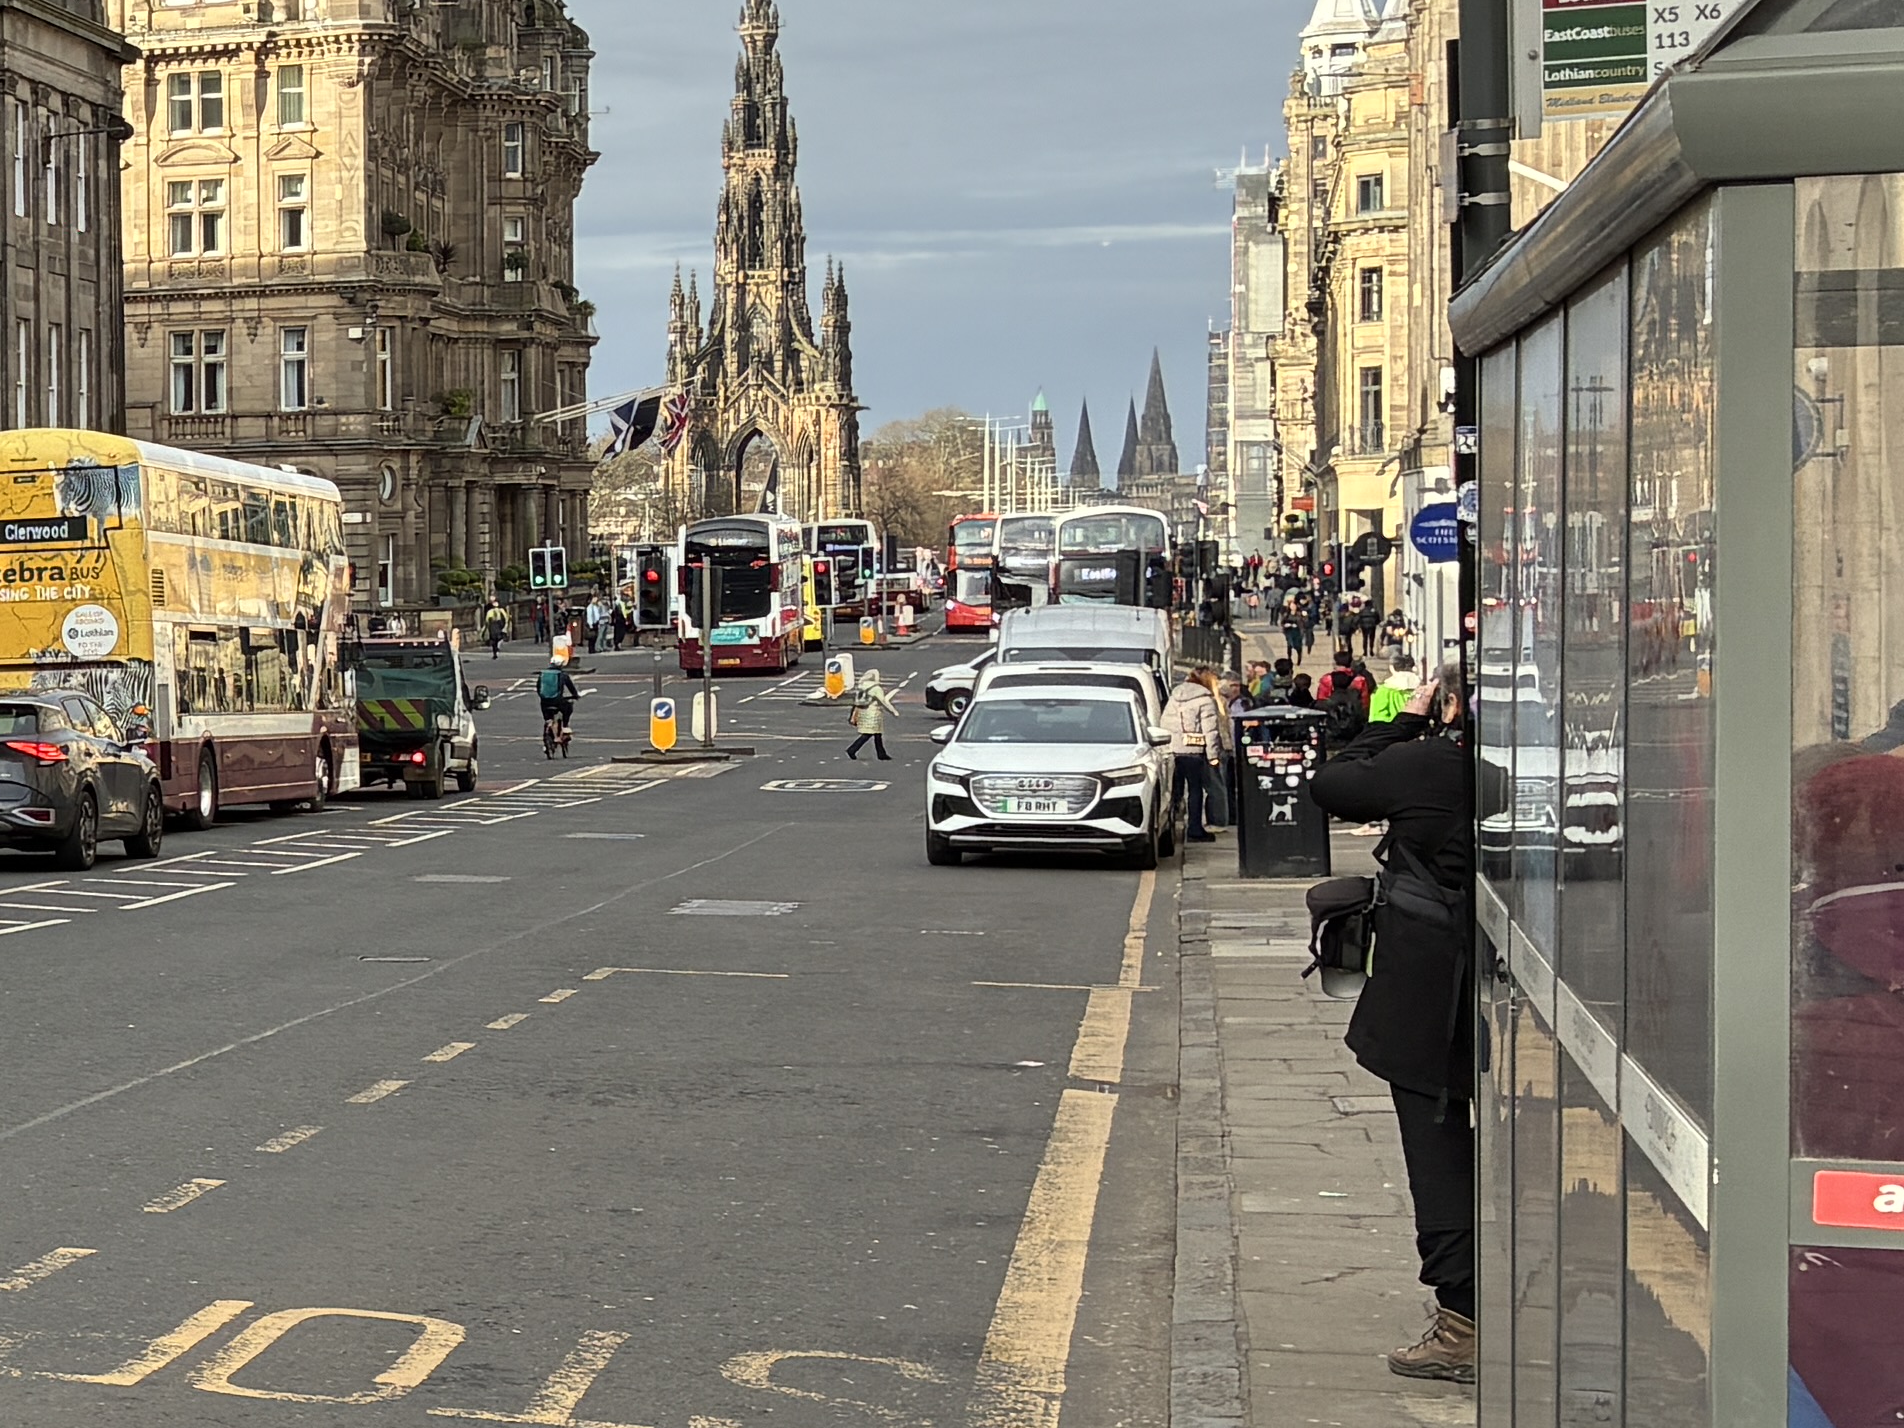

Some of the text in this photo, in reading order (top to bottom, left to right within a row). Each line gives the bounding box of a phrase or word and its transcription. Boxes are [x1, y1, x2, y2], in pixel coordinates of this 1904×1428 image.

[1653, 3, 1722, 23] X5 X6
[1544, 25, 1644, 43] EastCoastbuses
[1654, 32, 1690, 50] 113
[1544, 64, 1645, 82] Lothiancountry
[4, 521, 69, 541] Clerwood
[70, 566, 100, 582] BUS
[36, 586, 59, 601] THE
[63, 584, 91, 600] CITY
